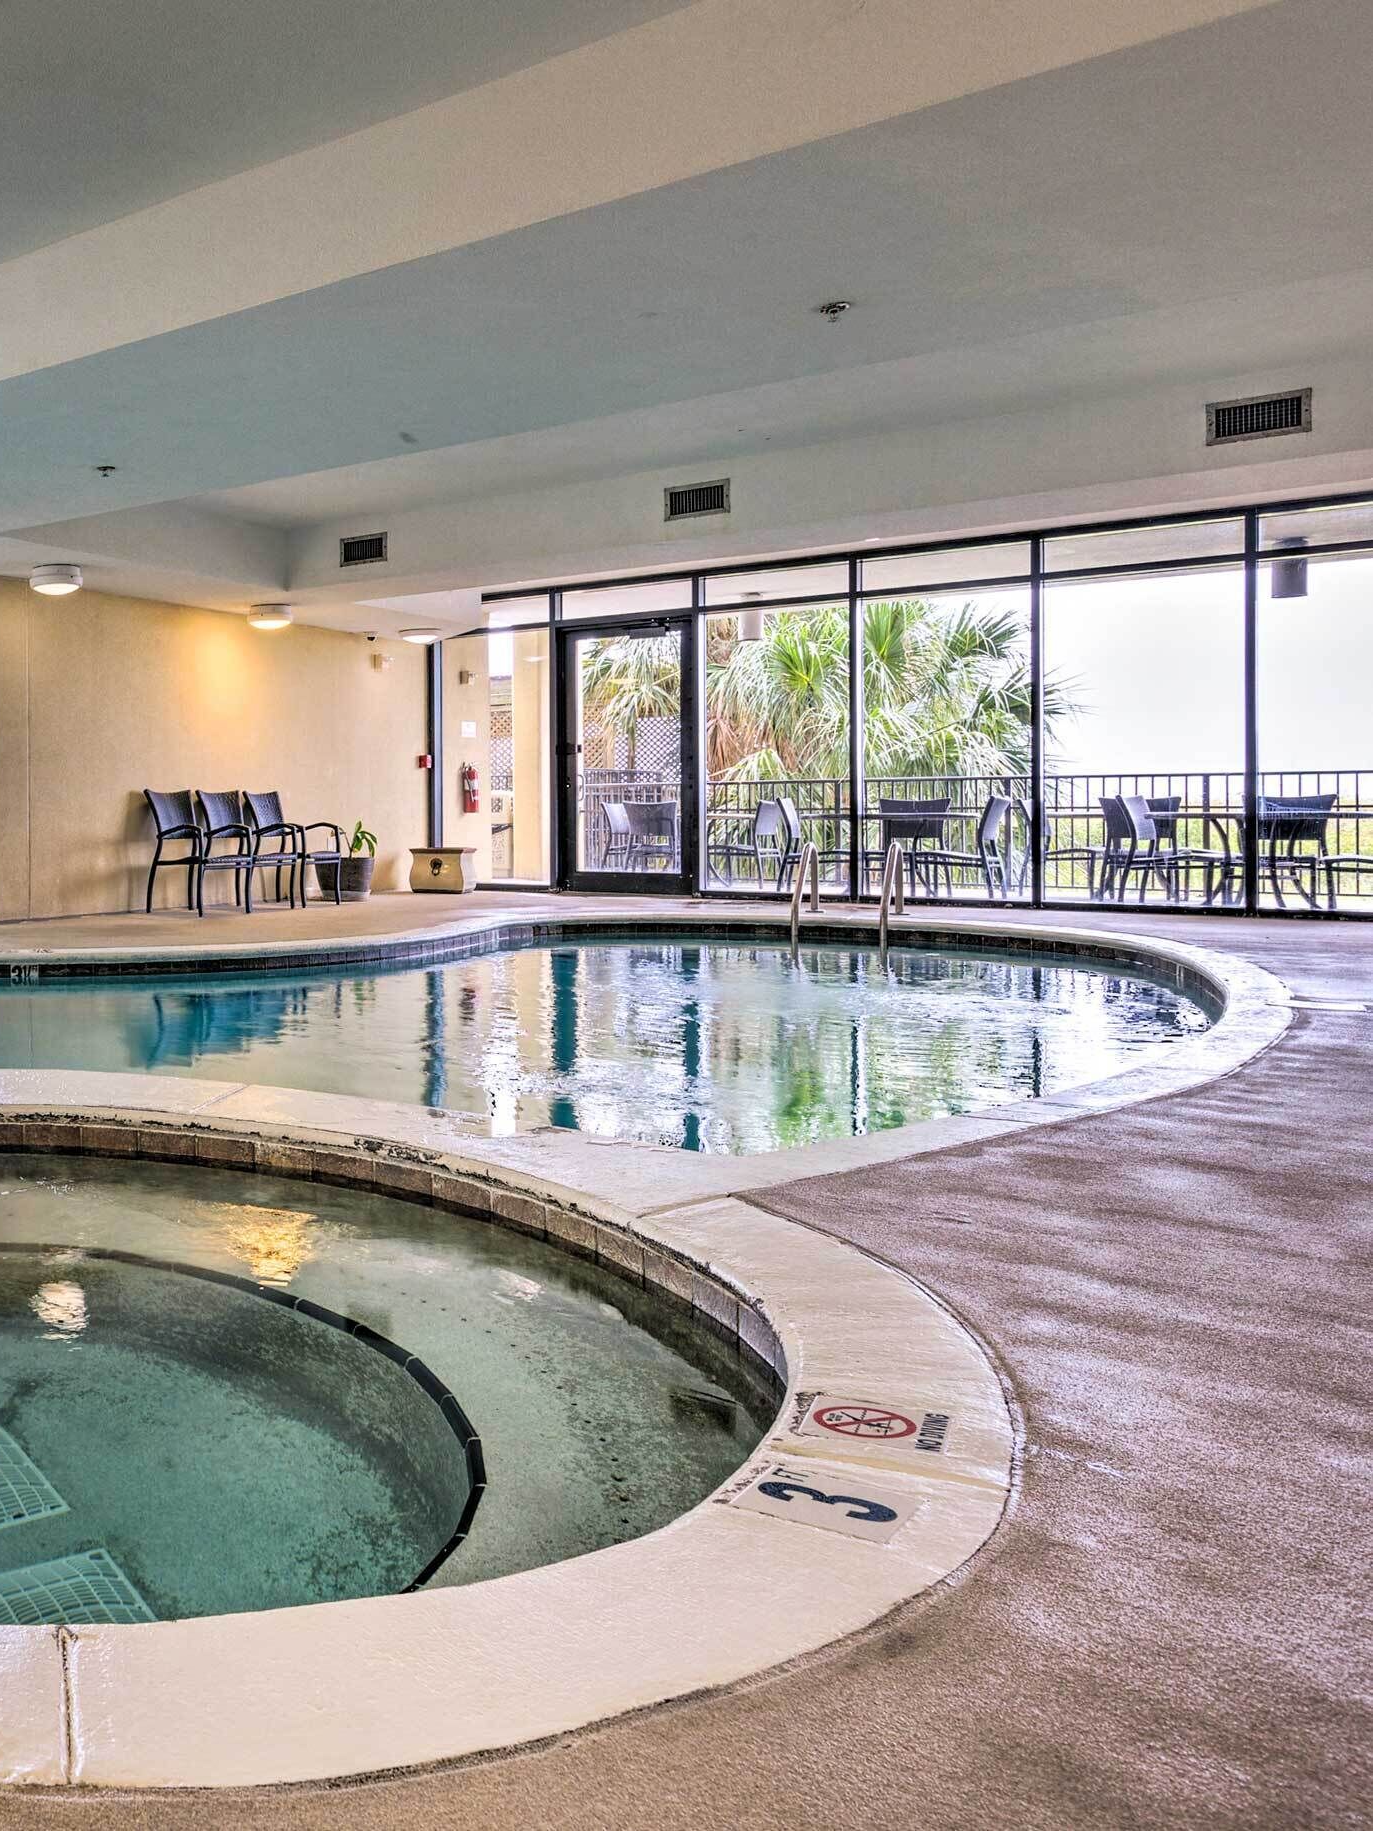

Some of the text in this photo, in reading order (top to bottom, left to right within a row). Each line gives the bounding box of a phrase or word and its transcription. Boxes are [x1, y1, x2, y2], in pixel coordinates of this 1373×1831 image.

[914, 1413, 950, 1453] NO DIVING
[757, 1467, 898, 1523] 3 FT
